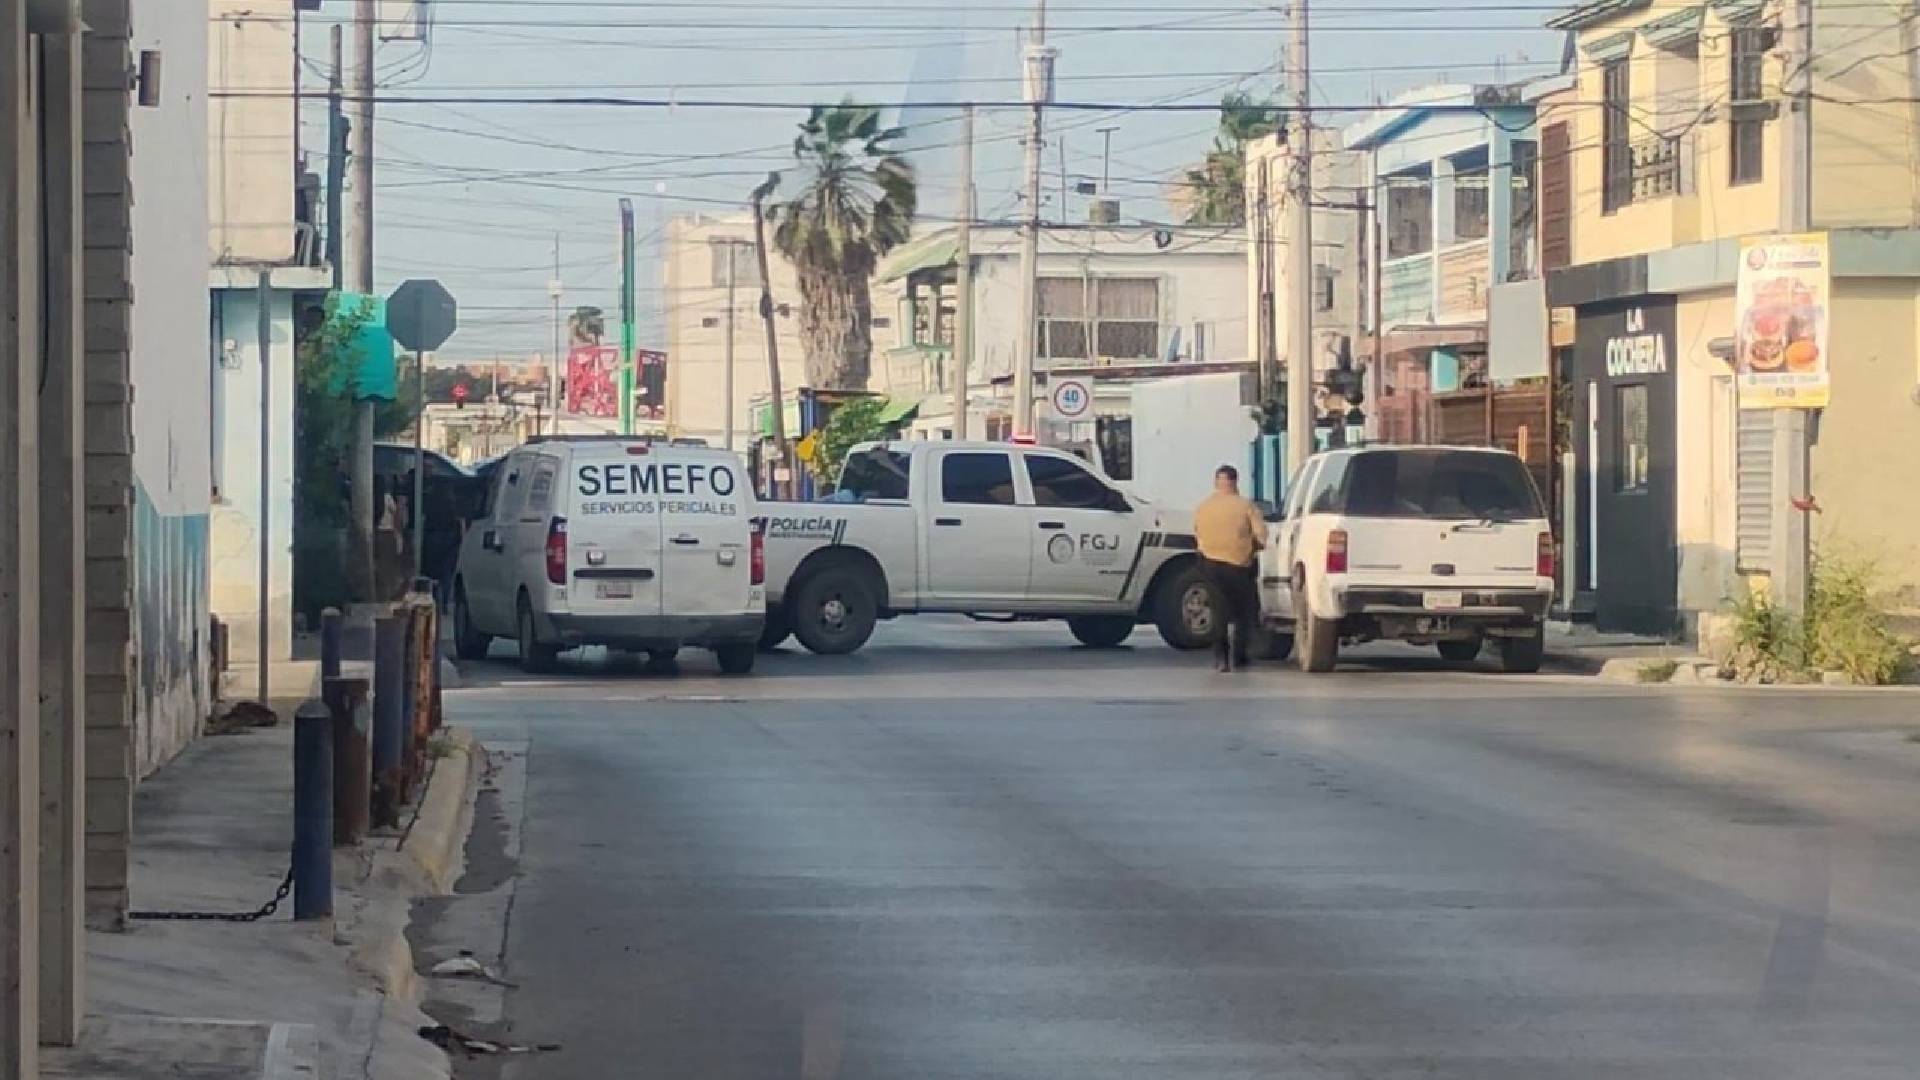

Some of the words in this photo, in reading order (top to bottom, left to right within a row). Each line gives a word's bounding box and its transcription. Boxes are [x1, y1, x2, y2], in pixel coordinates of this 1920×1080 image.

[1626, 307, 1644, 332] LA
[1607, 334, 1667, 376] COCHERA
[1063, 389, 1079, 402] 40
[578, 464, 734, 496] SEMEFO
[581, 501, 655, 515] SERVICIOS
[659, 501, 737, 516] PERICIALES
[770, 516, 832, 530] POLICÍA
[1080, 534, 1120, 550] FGJ
